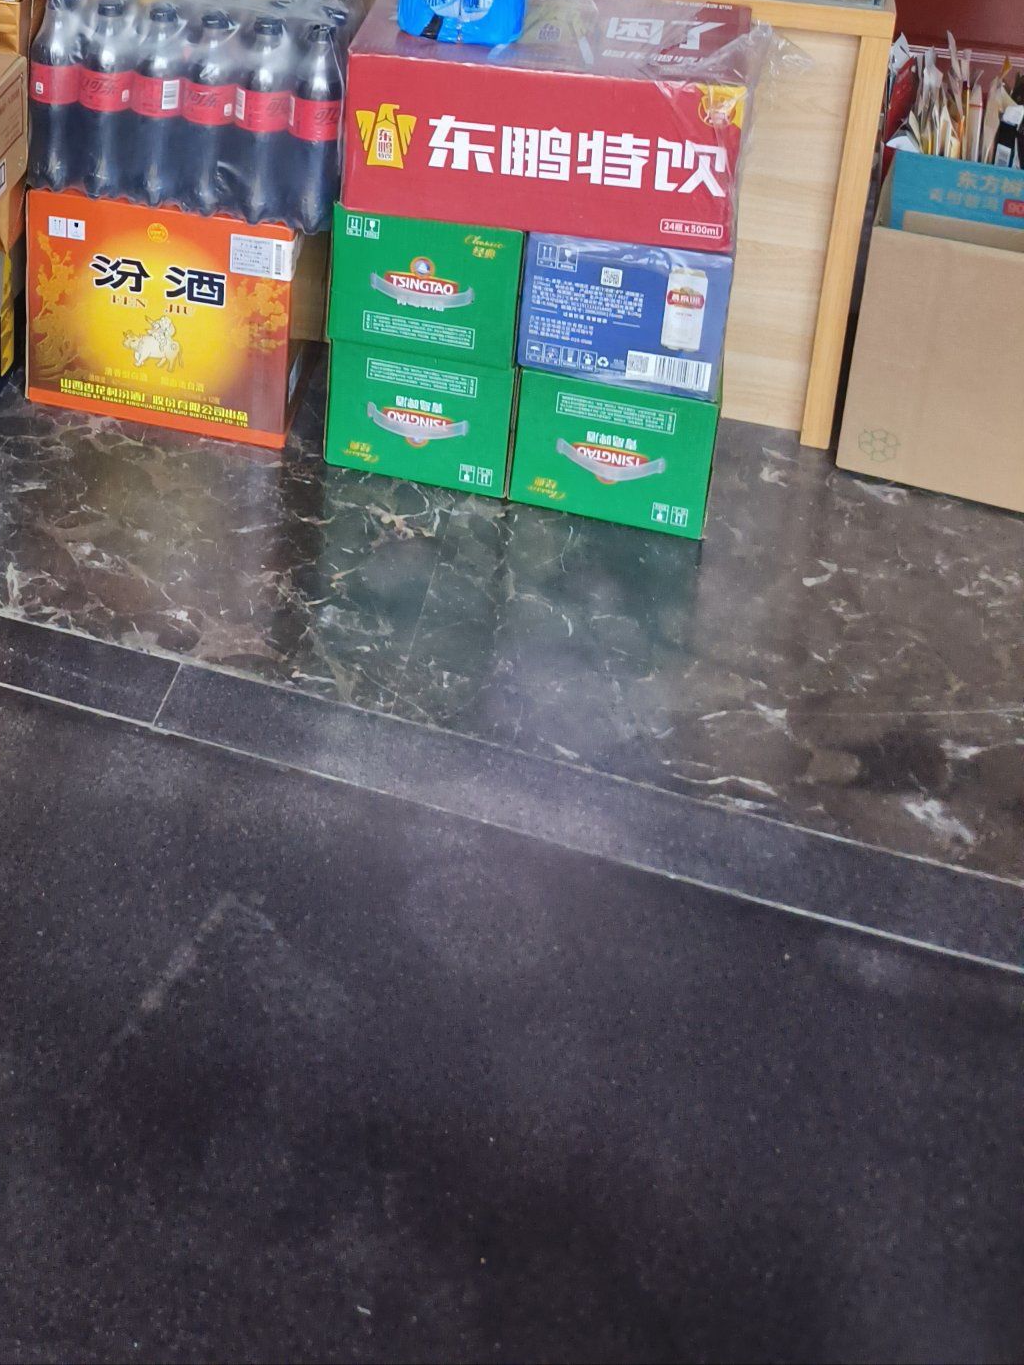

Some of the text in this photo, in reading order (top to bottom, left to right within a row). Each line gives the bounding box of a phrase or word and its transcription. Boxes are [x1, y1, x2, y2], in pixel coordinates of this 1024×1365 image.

[427, 114, 727, 198] 东鹏特饮
[472, 246, 497, 260] 经典
[90, 254, 227, 307] 汾酒
[390, 275, 455, 296] TSINGTAO
